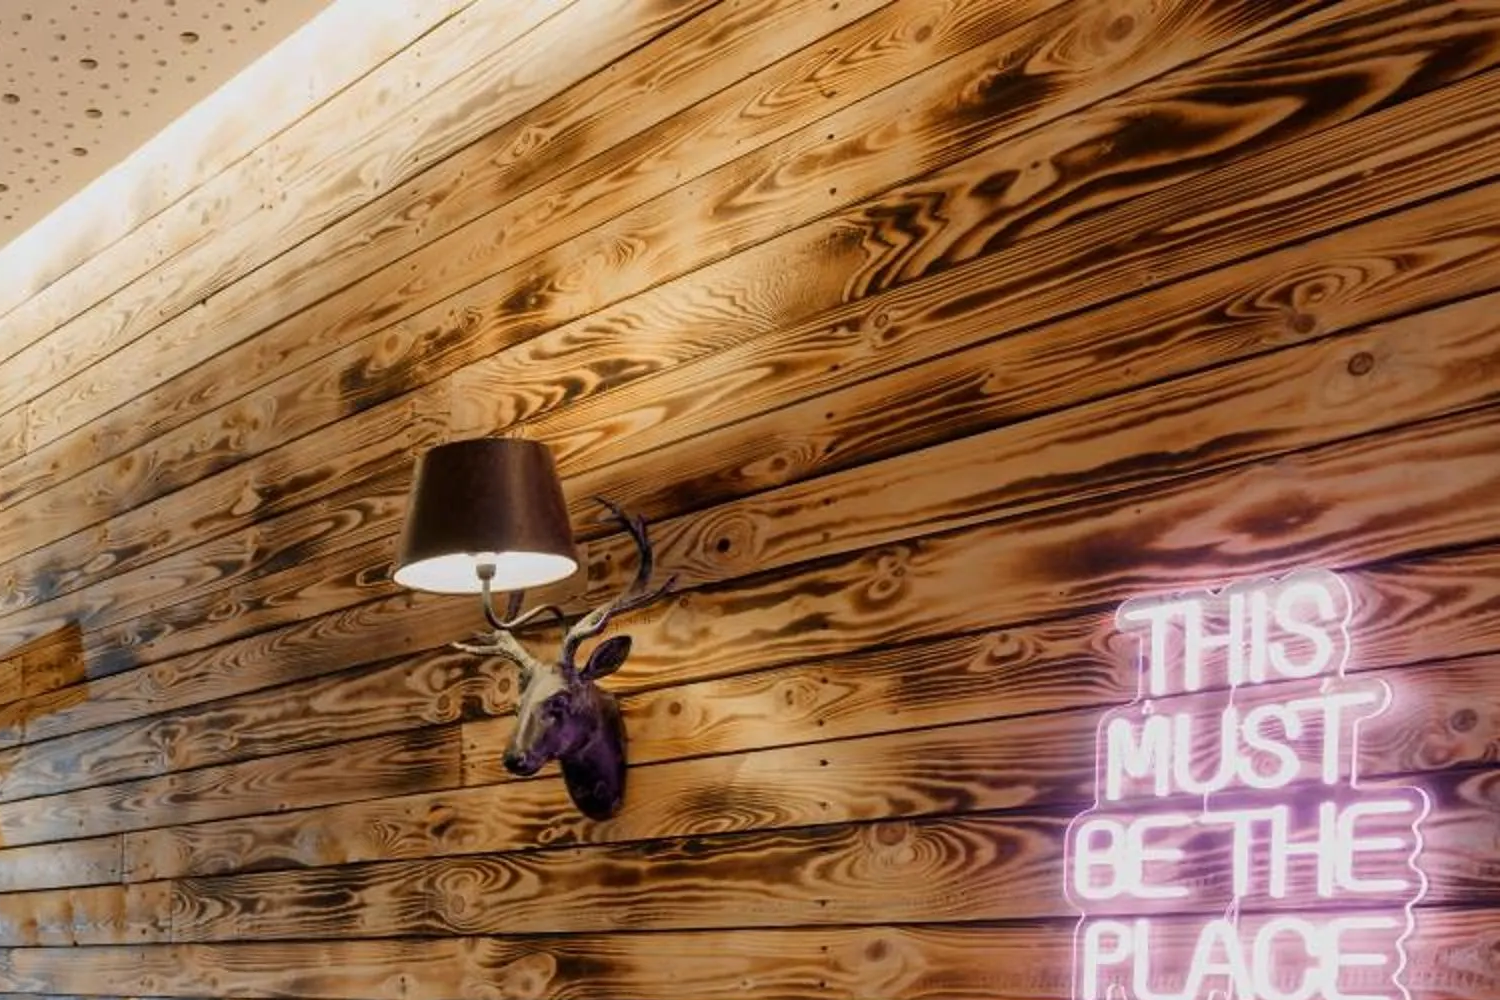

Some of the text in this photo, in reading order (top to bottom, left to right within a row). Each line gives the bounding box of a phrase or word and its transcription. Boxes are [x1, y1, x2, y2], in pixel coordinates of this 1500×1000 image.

[1122, 580, 1336, 696] THIS
[1106, 690, 1378, 800] MUST
[1074, 801, 1414, 899] BE THE
